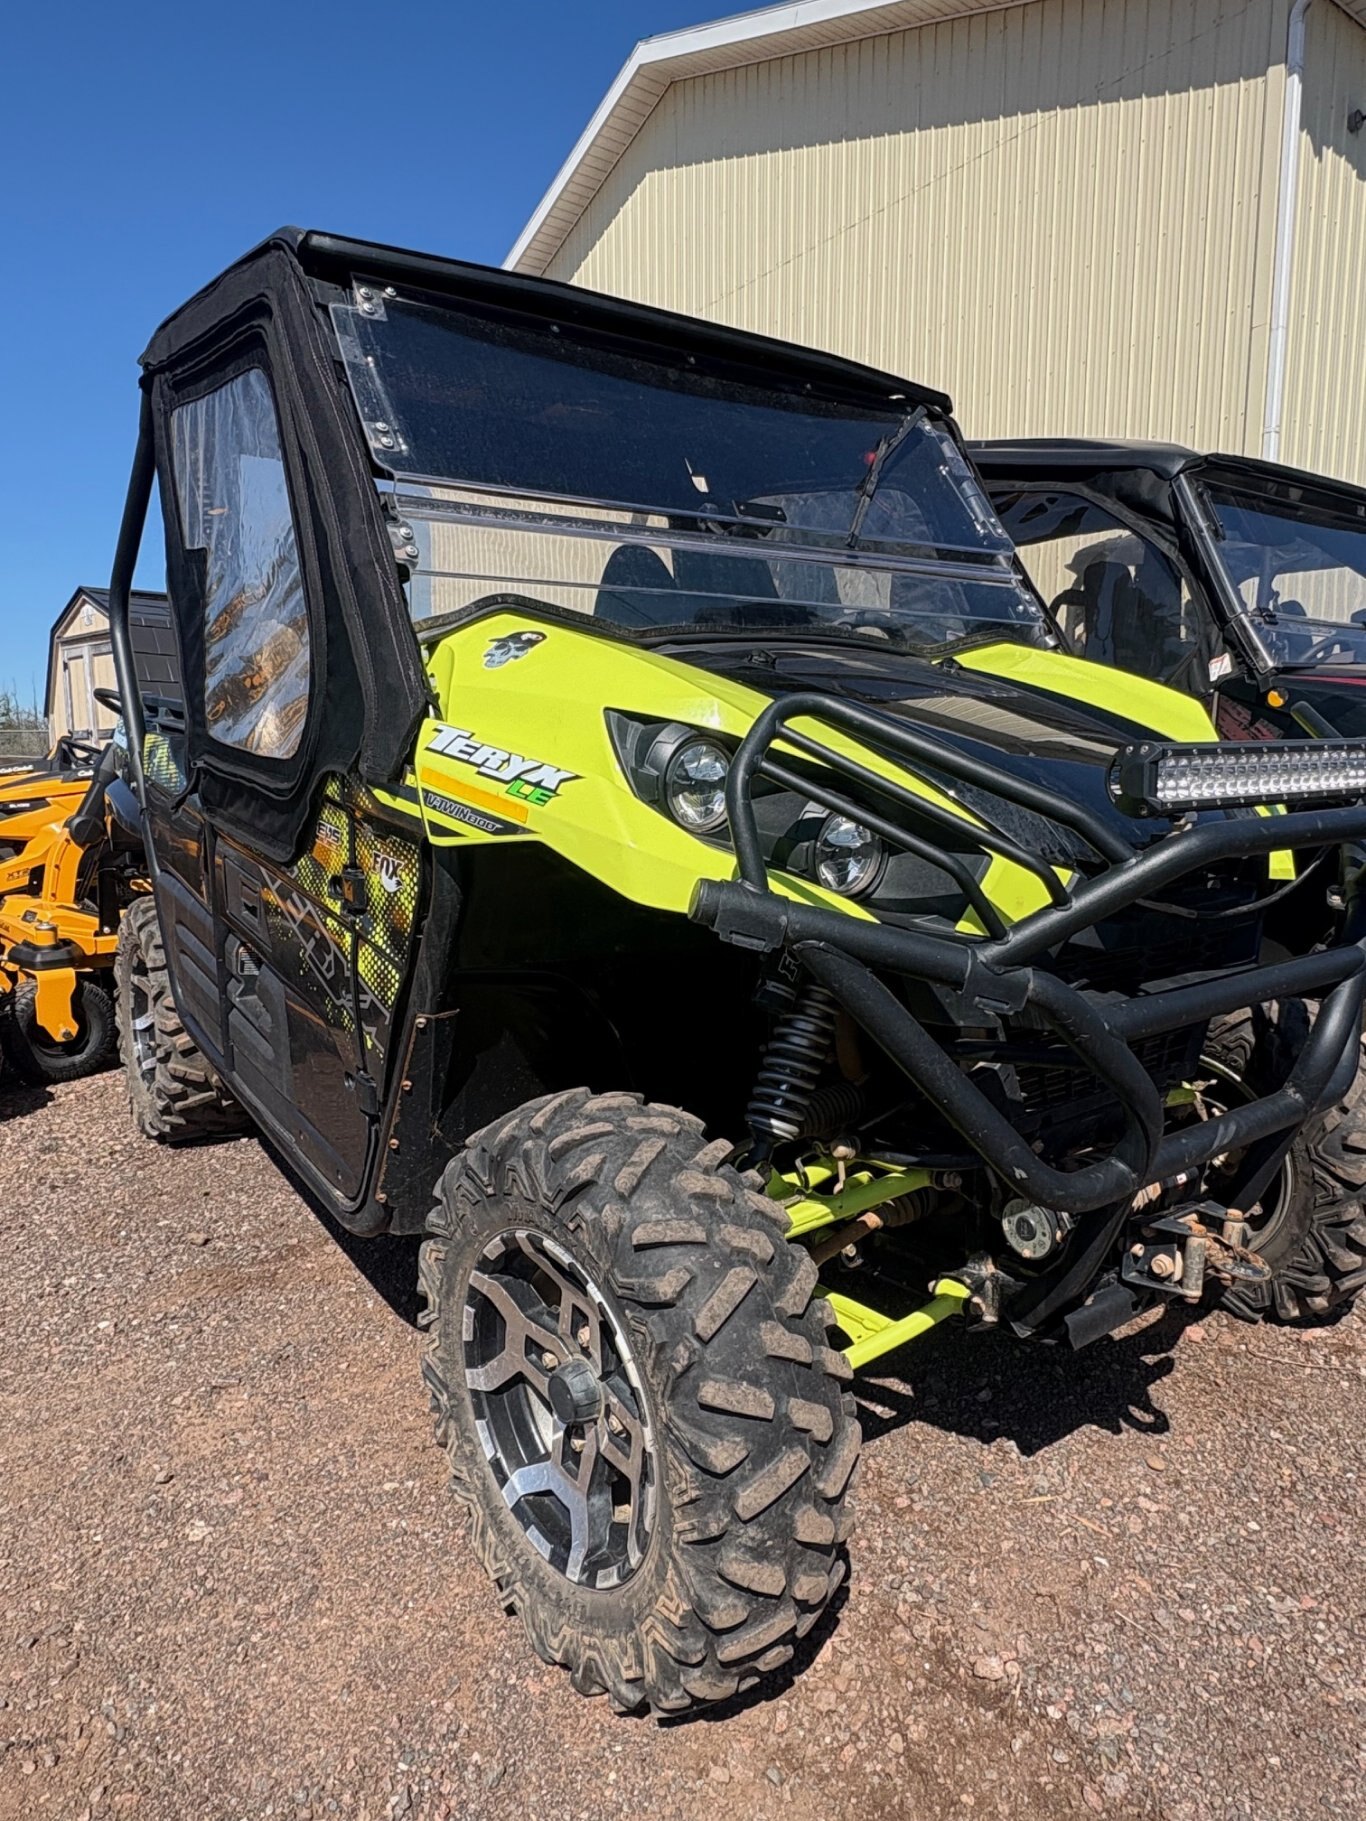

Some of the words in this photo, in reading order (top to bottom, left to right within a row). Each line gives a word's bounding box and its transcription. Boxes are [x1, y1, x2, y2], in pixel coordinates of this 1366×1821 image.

[425, 723, 583, 791] TERYX
[506, 779, 561, 806] LE
[372, 850, 405, 881] FOX
